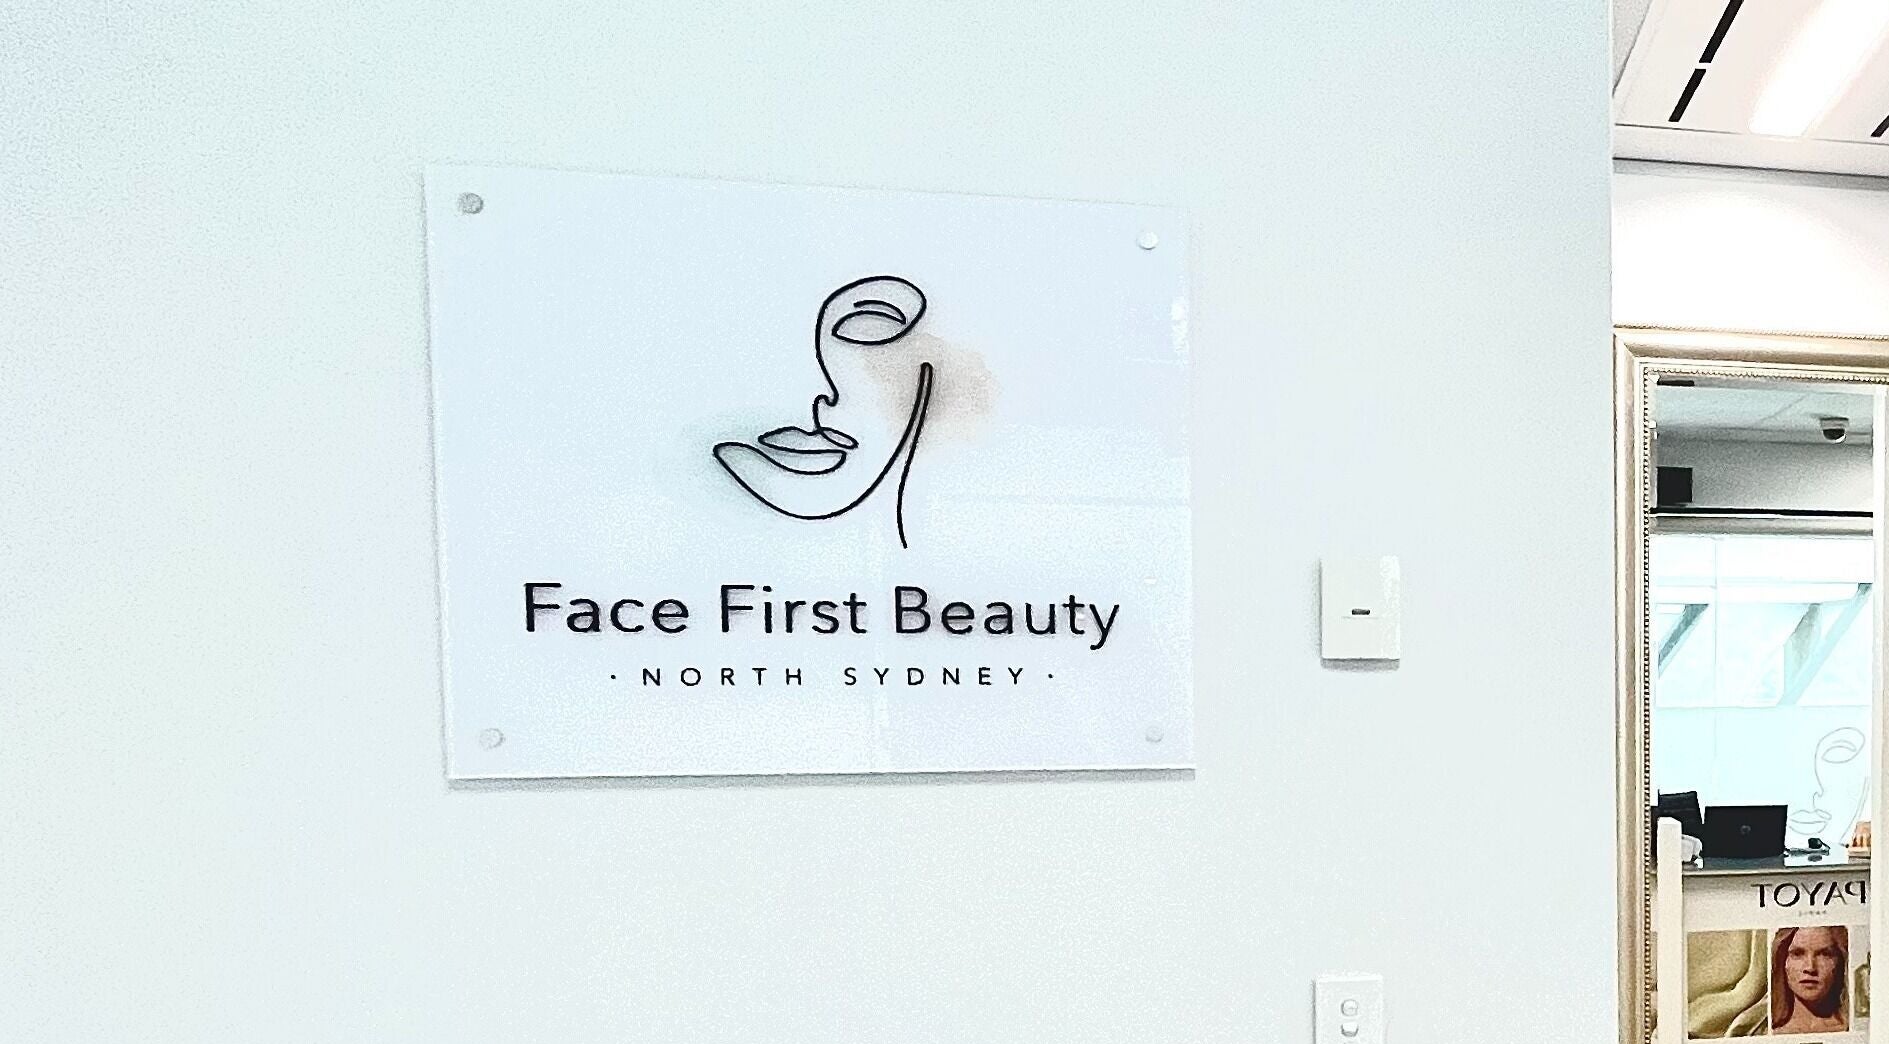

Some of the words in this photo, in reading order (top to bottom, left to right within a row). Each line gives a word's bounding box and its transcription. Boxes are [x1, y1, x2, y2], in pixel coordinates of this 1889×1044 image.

[523, 582, 690, 634] Face
[720, 584, 868, 634] First
[894, 585, 1120, 651] Beauty
[642, 667, 802, 687] NORTH
[844, 666, 1025, 686] SYDNEY
